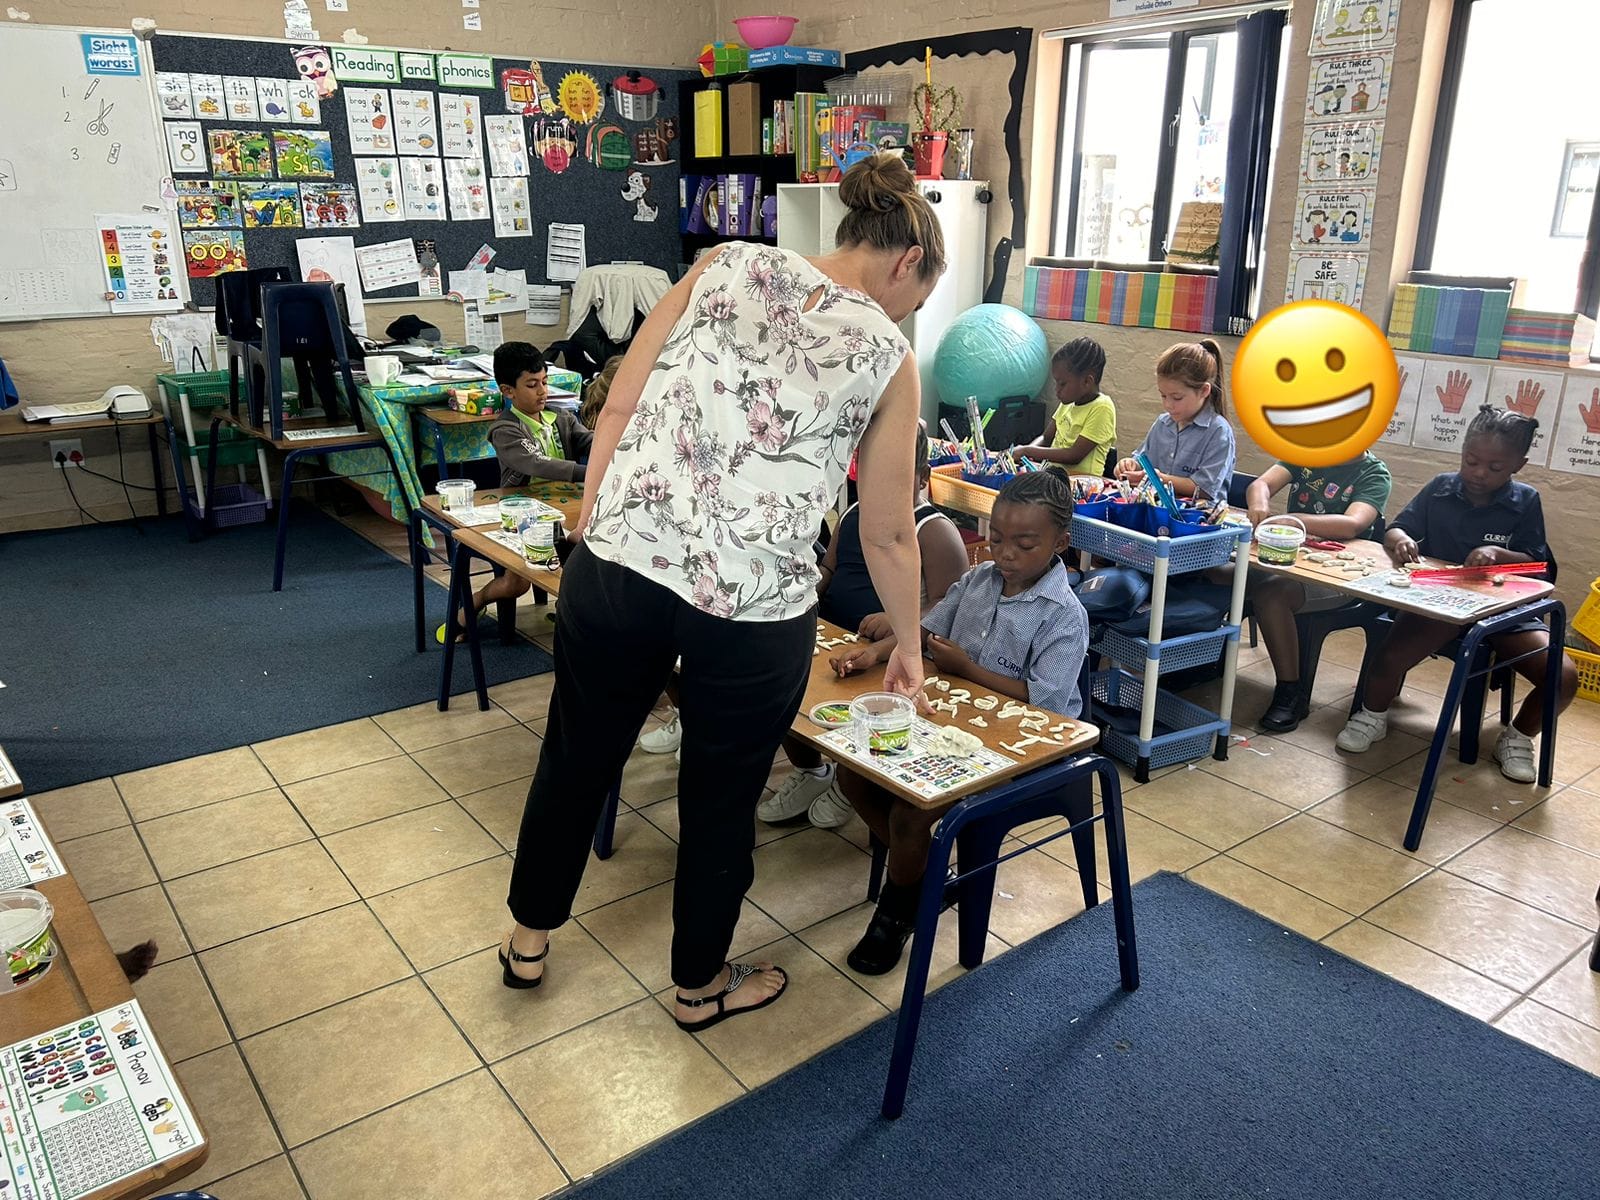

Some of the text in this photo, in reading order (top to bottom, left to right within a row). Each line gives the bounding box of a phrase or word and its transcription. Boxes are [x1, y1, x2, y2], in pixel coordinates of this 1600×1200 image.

[335, 52, 490, 83] Reading and phonics
[262, 82, 283, 97] wh
[293, 84, 315, 99] -ck
[173, 130, 197, 143] -ng
[71, 147, 79, 160] 3
[316, 204, 348, 223] ee
[106, 231, 113, 240] 5
[190, 244, 226, 261] oo
[111, 255, 117, 264] 3
[113, 267, 119, 276] 2
[1431, 414, 1466, 426] What will
[1434, 424, 1459, 435] happen
[1582, 435, 1600, 446] Here
[1568, 447, 1593, 455] comes
[1569, 457, 1600, 466] questio
[997, 656, 1022, 674] CURR
[127, 1051, 152, 1085] Pranav
[169, 1129, 189, 1149] right
[42, 1181, 55, 1200] Sunda
